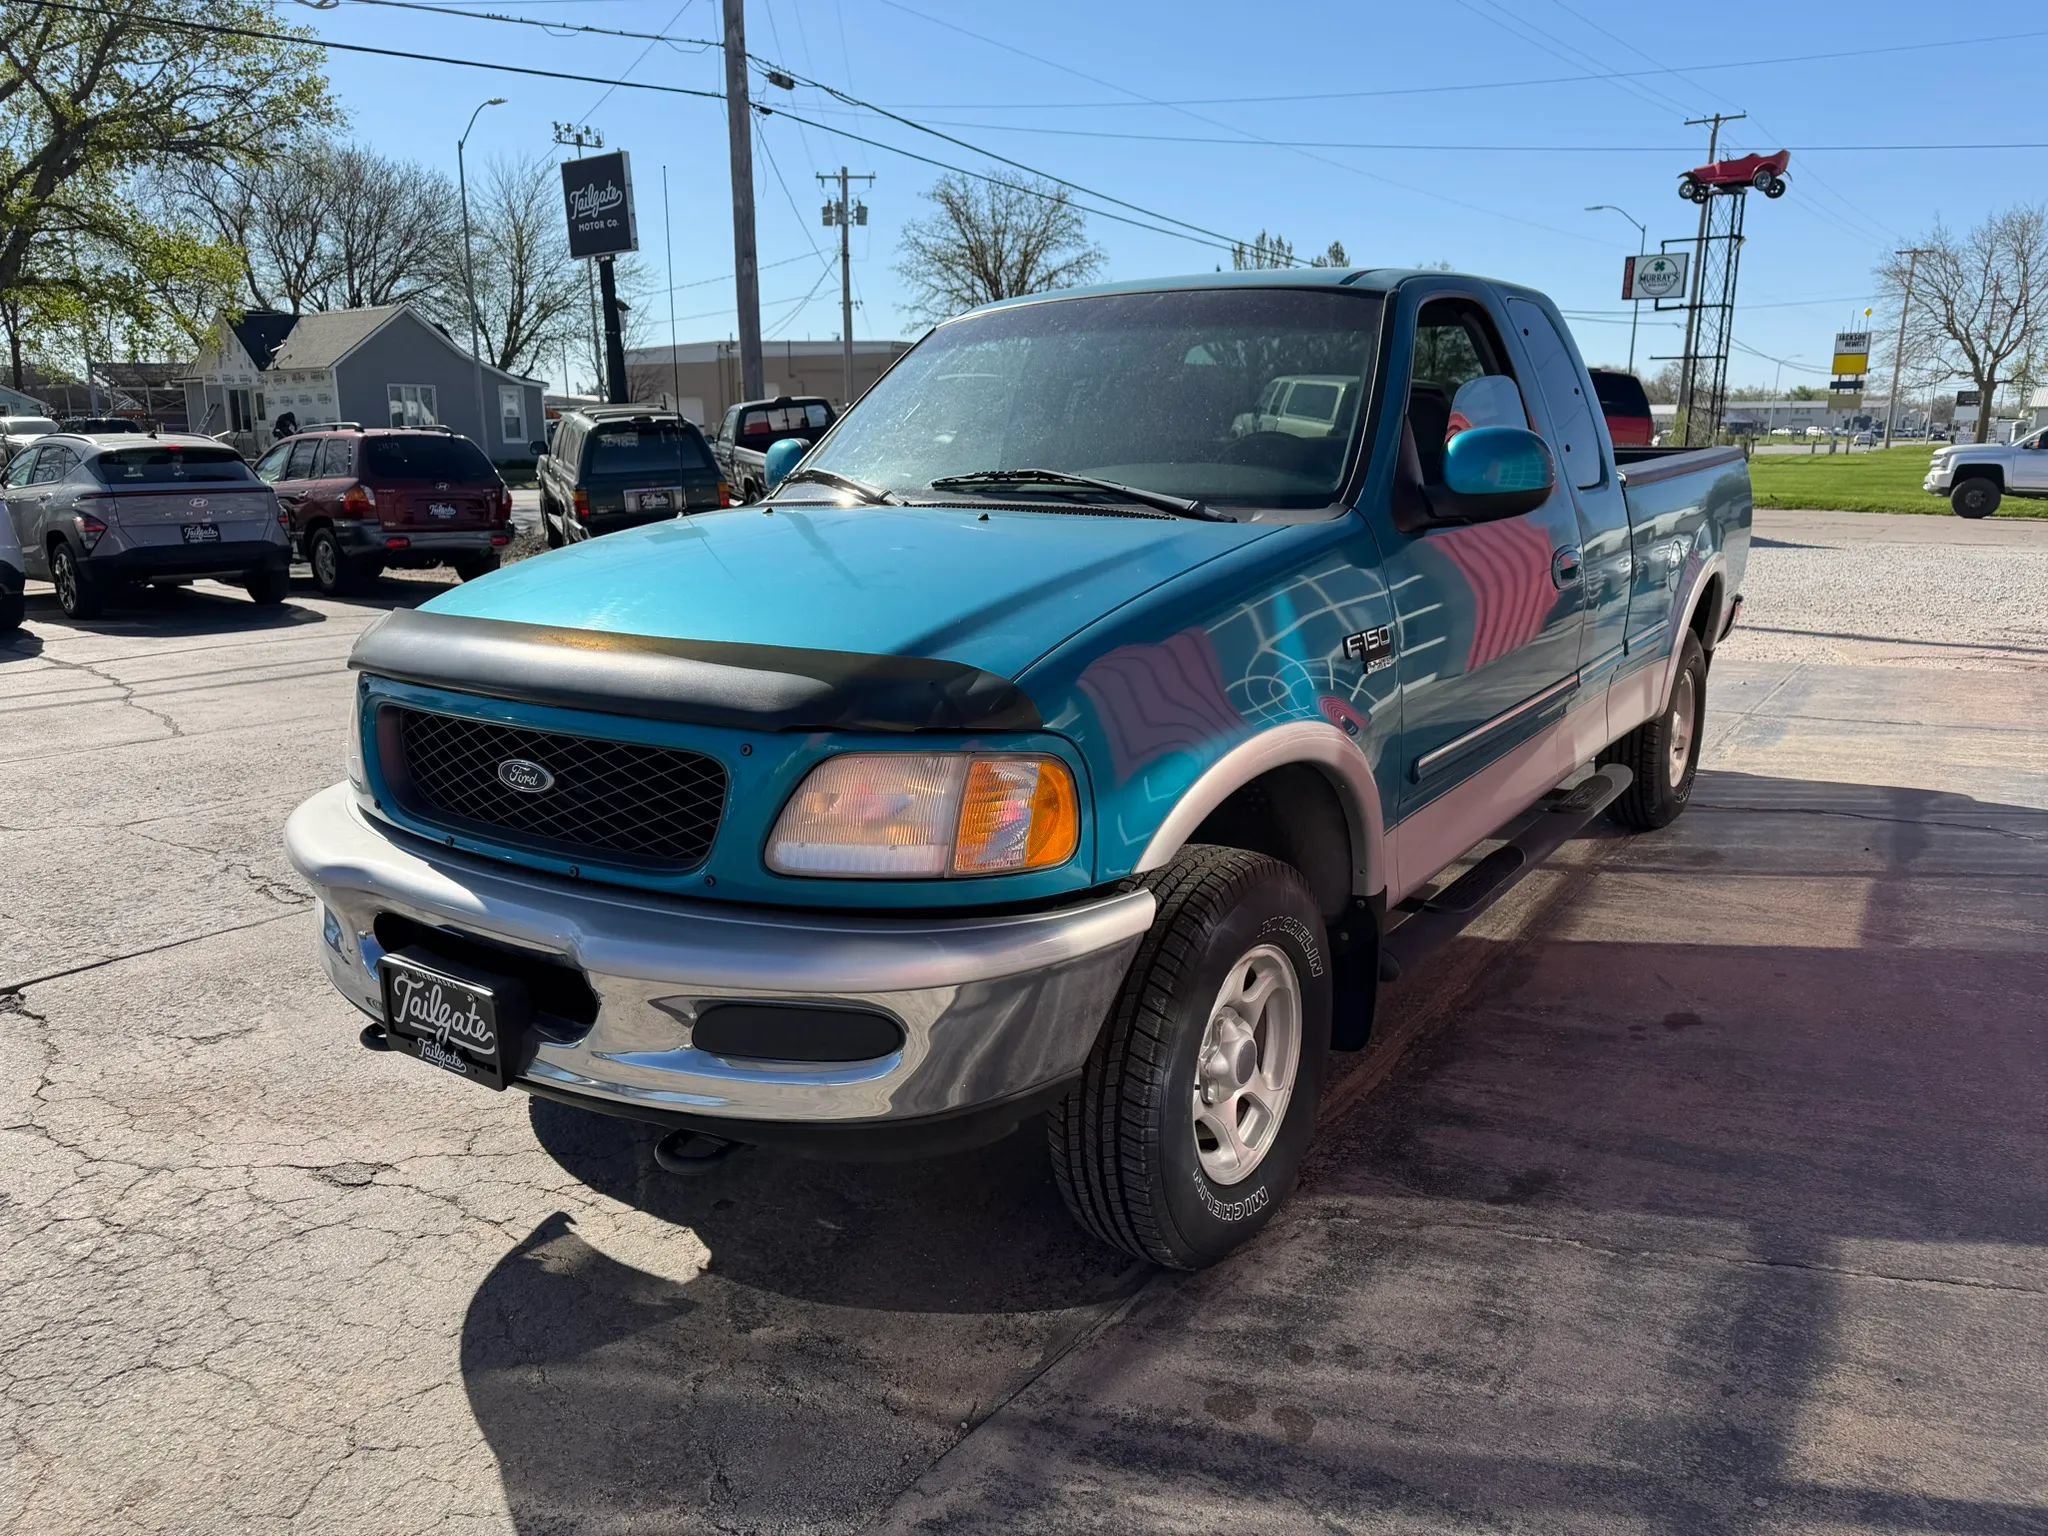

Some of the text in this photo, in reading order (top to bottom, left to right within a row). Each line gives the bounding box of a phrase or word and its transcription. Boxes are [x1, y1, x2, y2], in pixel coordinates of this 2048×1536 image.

[569, 180, 622, 219] Tailgate
[578, 220, 605, 232] MOTOR
[1638, 271, 1680, 284] MURRAY'S
[1347, 626, 1390, 657] F-150
[510, 764, 538, 786] Ford
[416, 970, 458, 990] NEBRASKA
[394, 974, 496, 1055] Tailgate
[417, 1037, 467, 1073] Tailgate
[1193, 1167, 1270, 1221] MICHELIN
